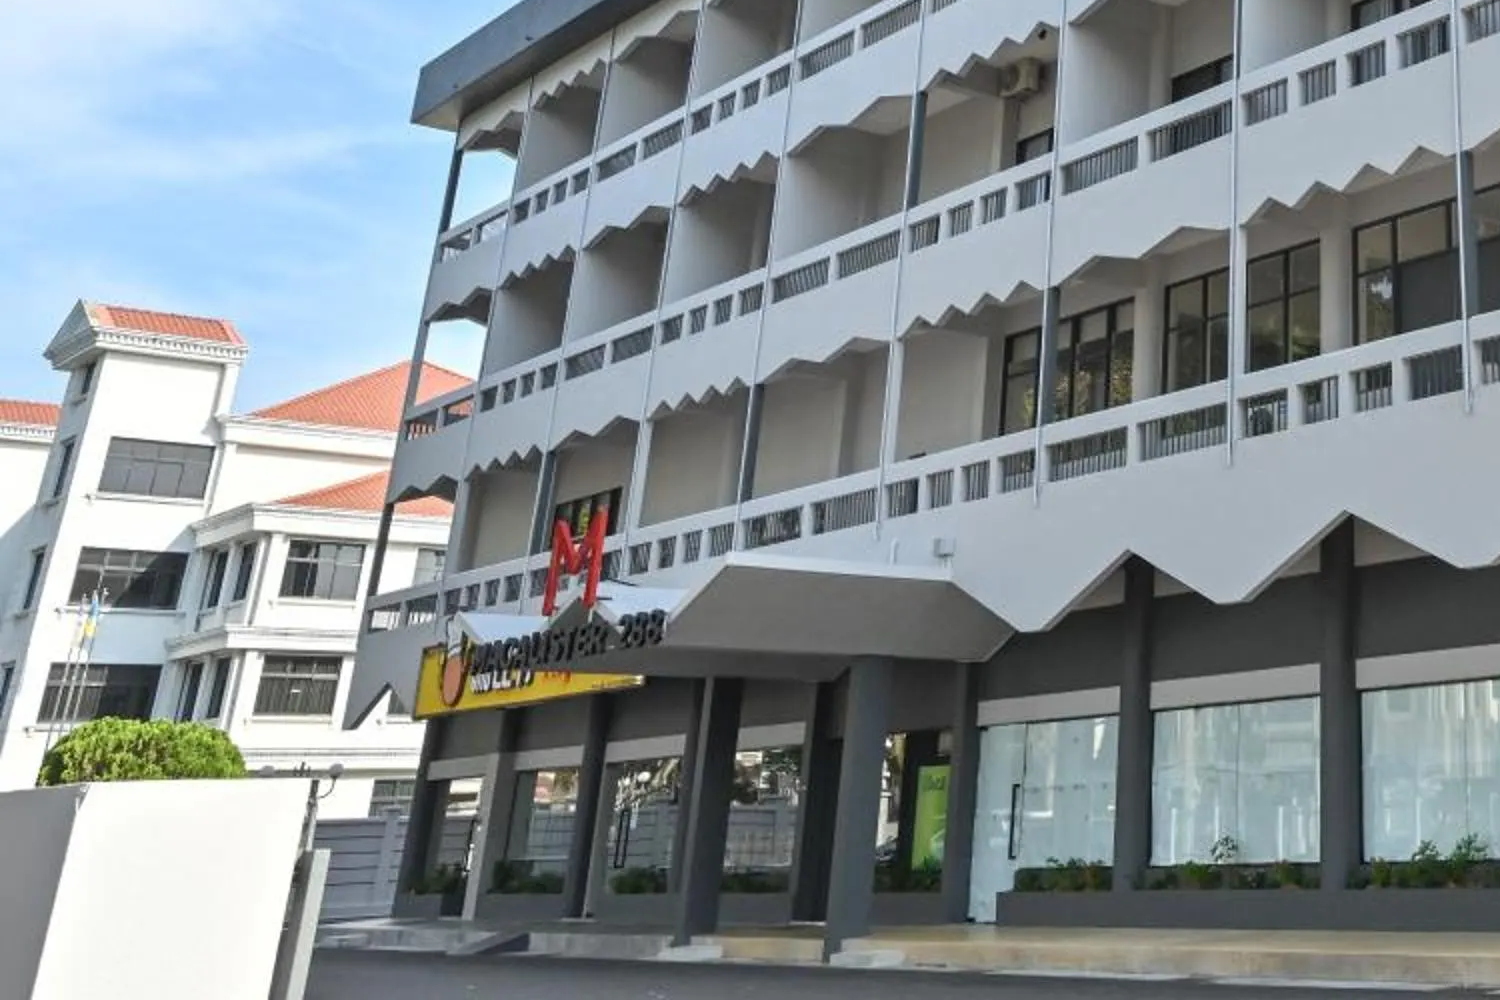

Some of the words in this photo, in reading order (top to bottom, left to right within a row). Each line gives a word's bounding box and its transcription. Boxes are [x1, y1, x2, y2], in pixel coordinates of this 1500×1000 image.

[542, 504, 609, 617] M
[470, 622, 610, 676] MACALISTER
[619, 608, 667, 649] 288
